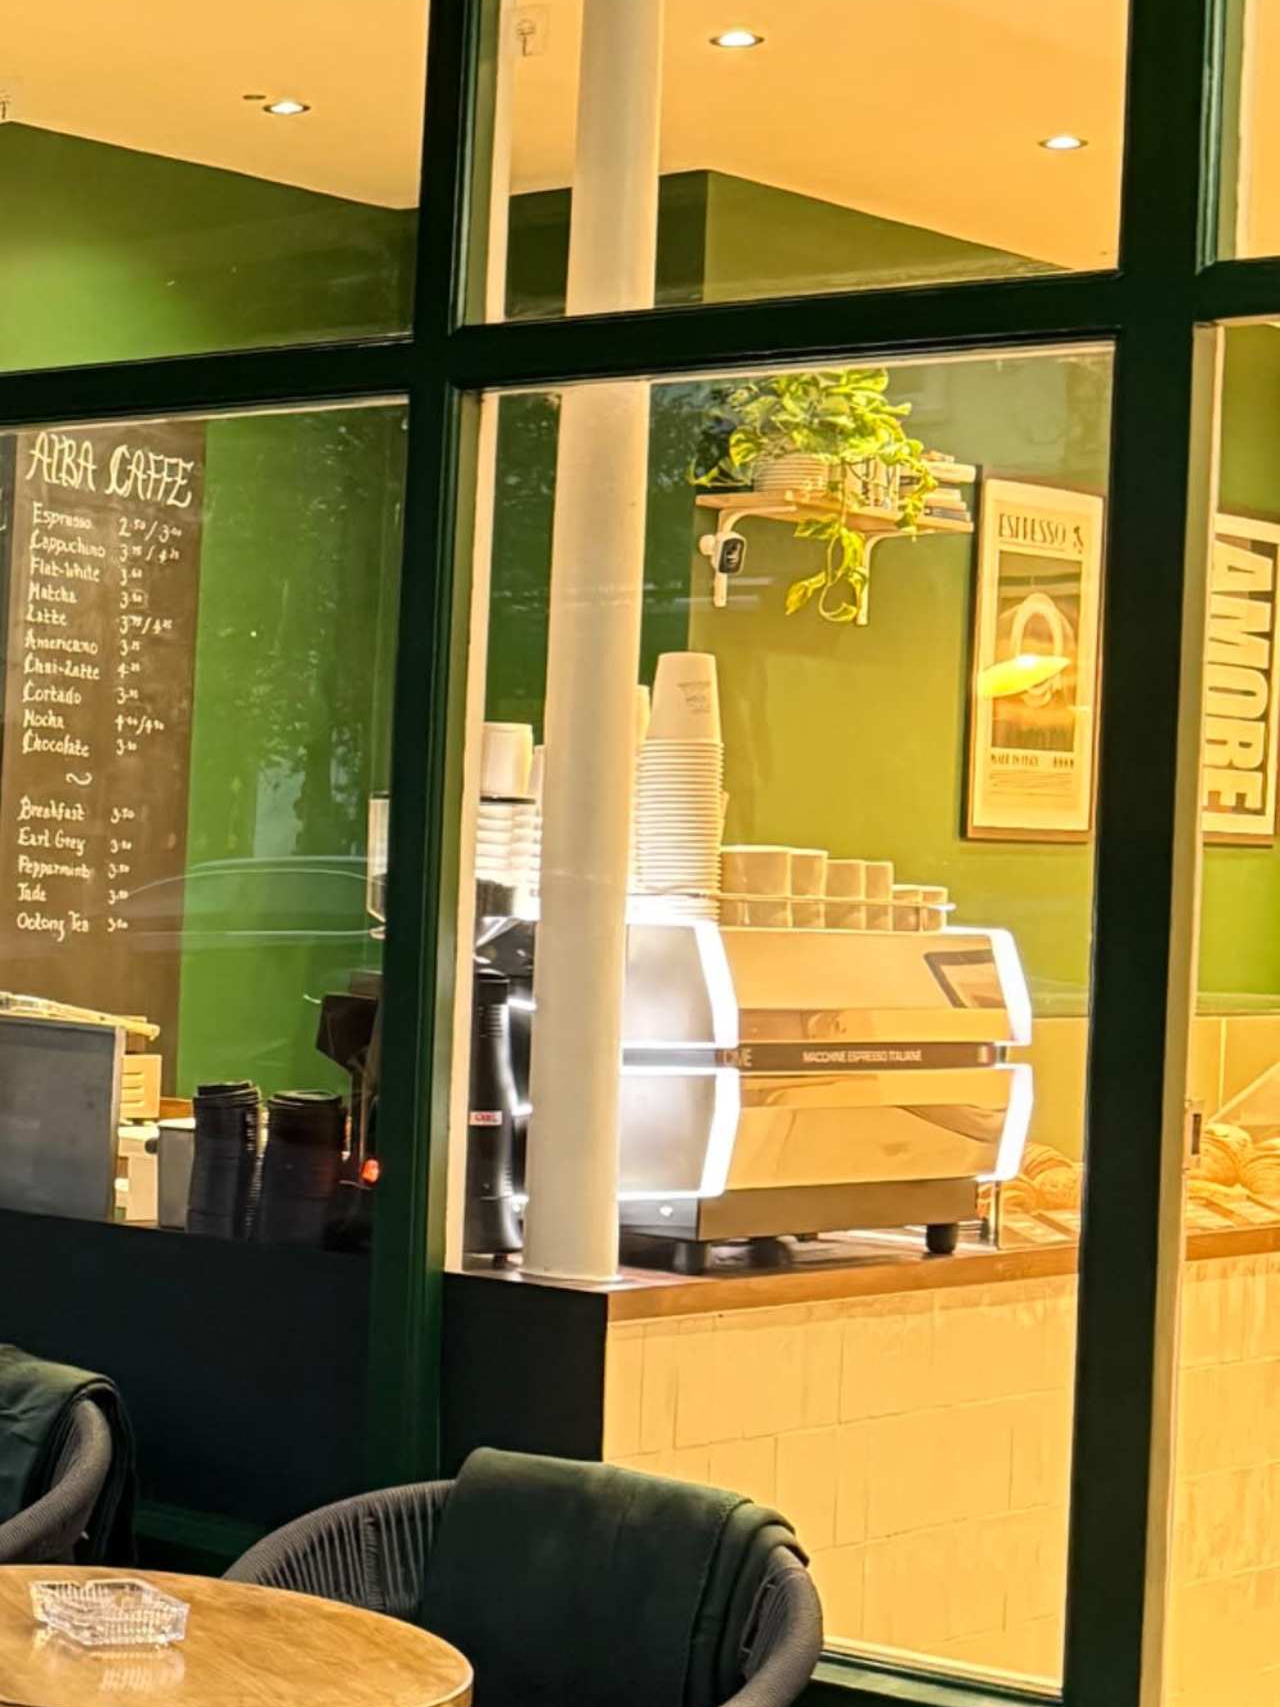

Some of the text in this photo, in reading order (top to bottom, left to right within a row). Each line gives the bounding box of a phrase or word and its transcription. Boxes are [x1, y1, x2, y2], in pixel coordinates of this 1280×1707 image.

[27, 580, 78, 604] Matcha
[26, 604, 67, 626] Latte
[25, 628, 99, 655] Americano
[1201, 540, 1274, 810] AMORE
[23, 680, 82, 705] Cortado
[23, 709, 65, 730] Mocha
[22, 728, 90, 757] Chocolate
[17, 795, 86, 821] Breakfast
[17, 827, 50, 848] Earl
[54, 829, 86, 856] Grey
[68, 910, 90, 932] Tea
